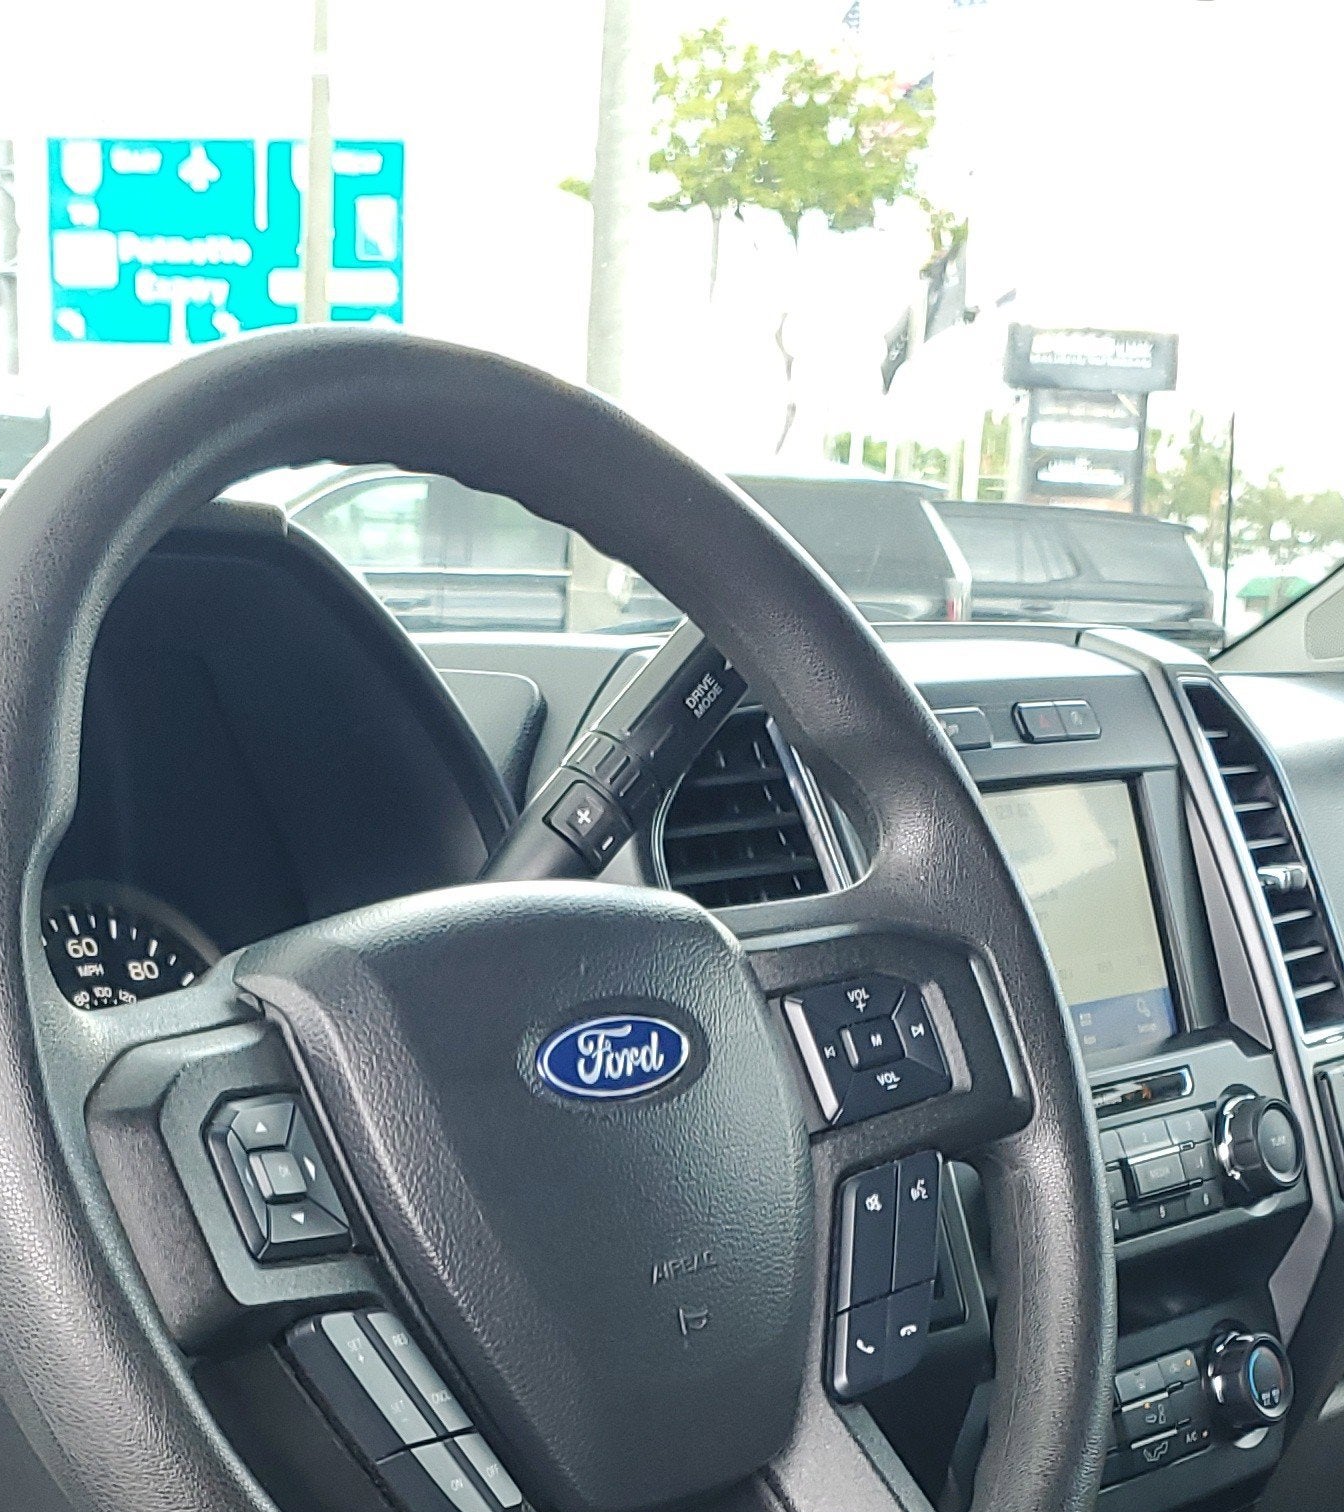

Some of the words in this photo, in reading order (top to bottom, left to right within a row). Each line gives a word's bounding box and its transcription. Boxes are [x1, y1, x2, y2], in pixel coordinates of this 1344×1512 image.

[685, 672, 715, 710] DRIVE
[693, 682, 723, 719] MODE
[66, 938, 98, 958] 60
[76, 963, 104, 977] MPH
[127, 960, 159, 981] 80
[93, 985, 112, 998] 100
[847, 986, 870, 1003] VOL
[577, 1024, 665, 1085] Ford
[876, 1071, 900, 1086] VOL
[1186, 1432, 1198, 1444] A/C
[487, 1464, 500, 1478] OFF
[450, 1478, 464, 1492] ON
